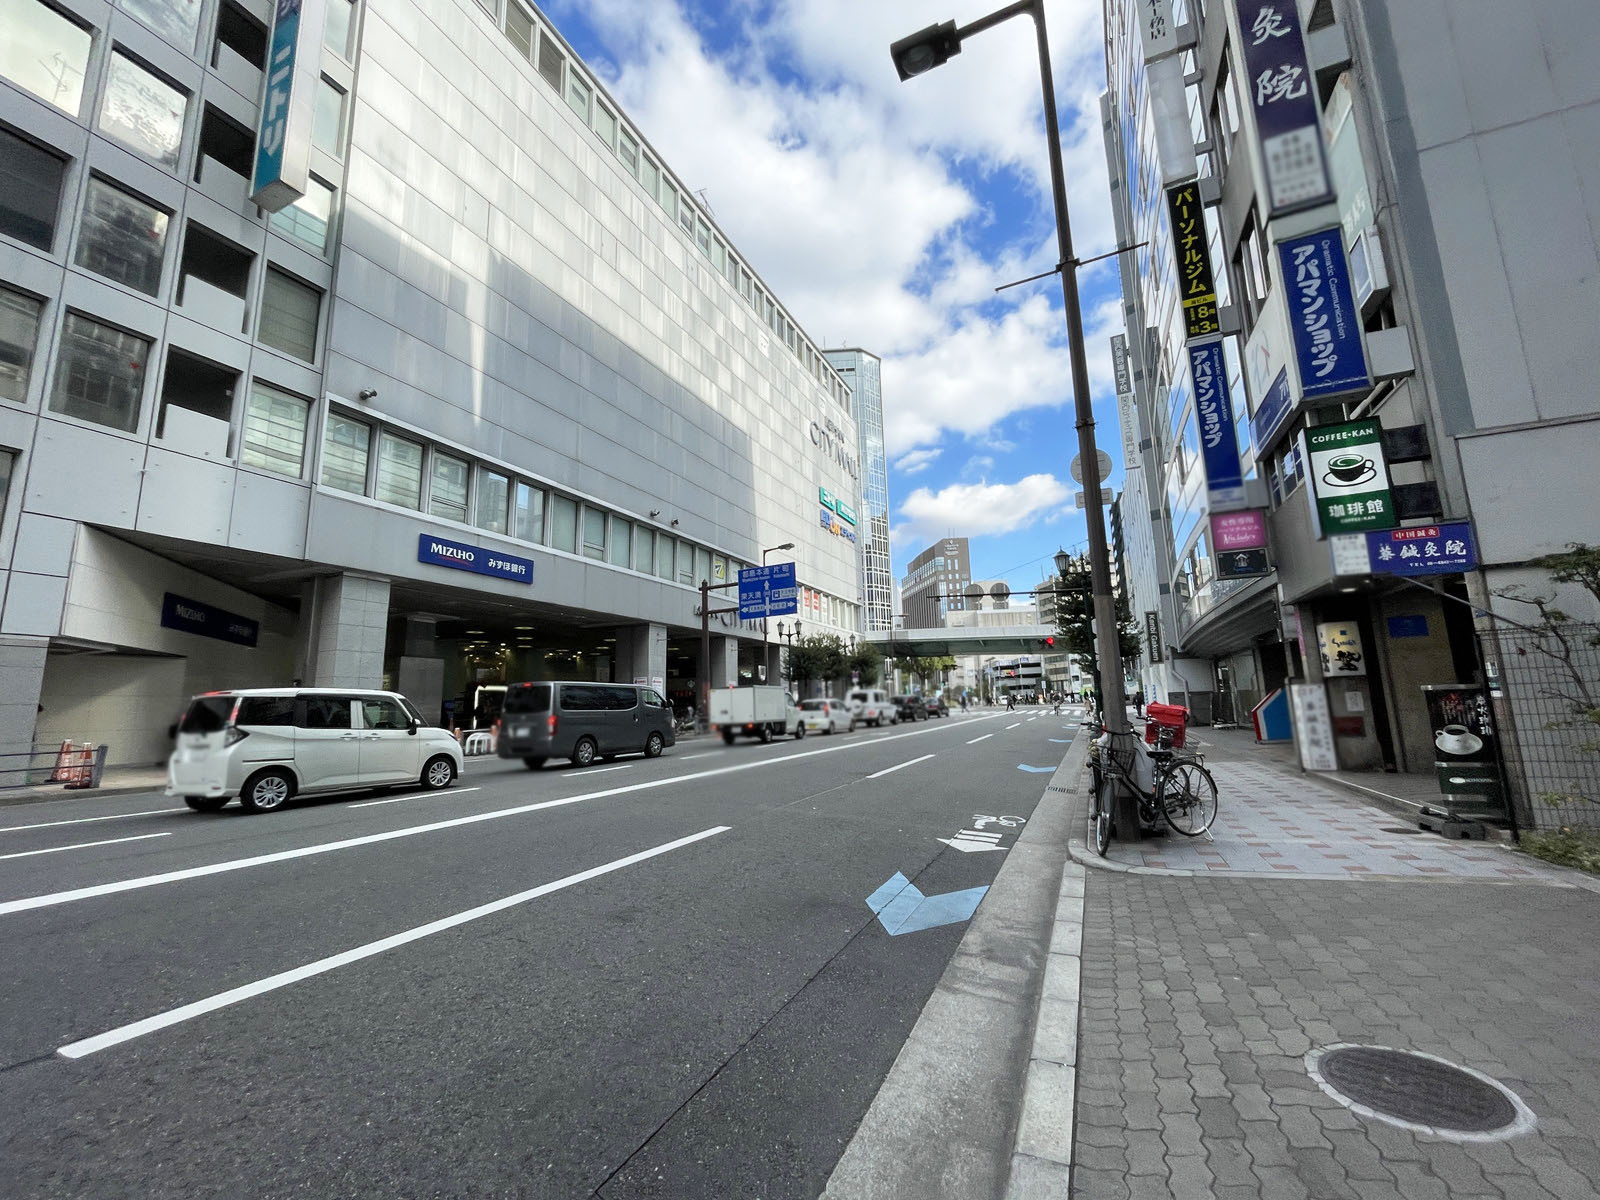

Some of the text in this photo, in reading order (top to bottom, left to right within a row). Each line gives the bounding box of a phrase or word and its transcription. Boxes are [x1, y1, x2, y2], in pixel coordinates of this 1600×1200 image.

[262, 45, 292, 157] ニトリ
[1175, 187, 1207, 294] パーソナルジム
[1291, 243, 1338, 377] アパマンショップ
[1329, 277, 1346, 340] Communication
[1192, 349, 1223, 449] アパマンショップ
[1328, 498, 1385, 518] 珈琲館
[430, 542, 475, 562] MIZUHO
[487, 558, 527, 575] みずほ銀行
